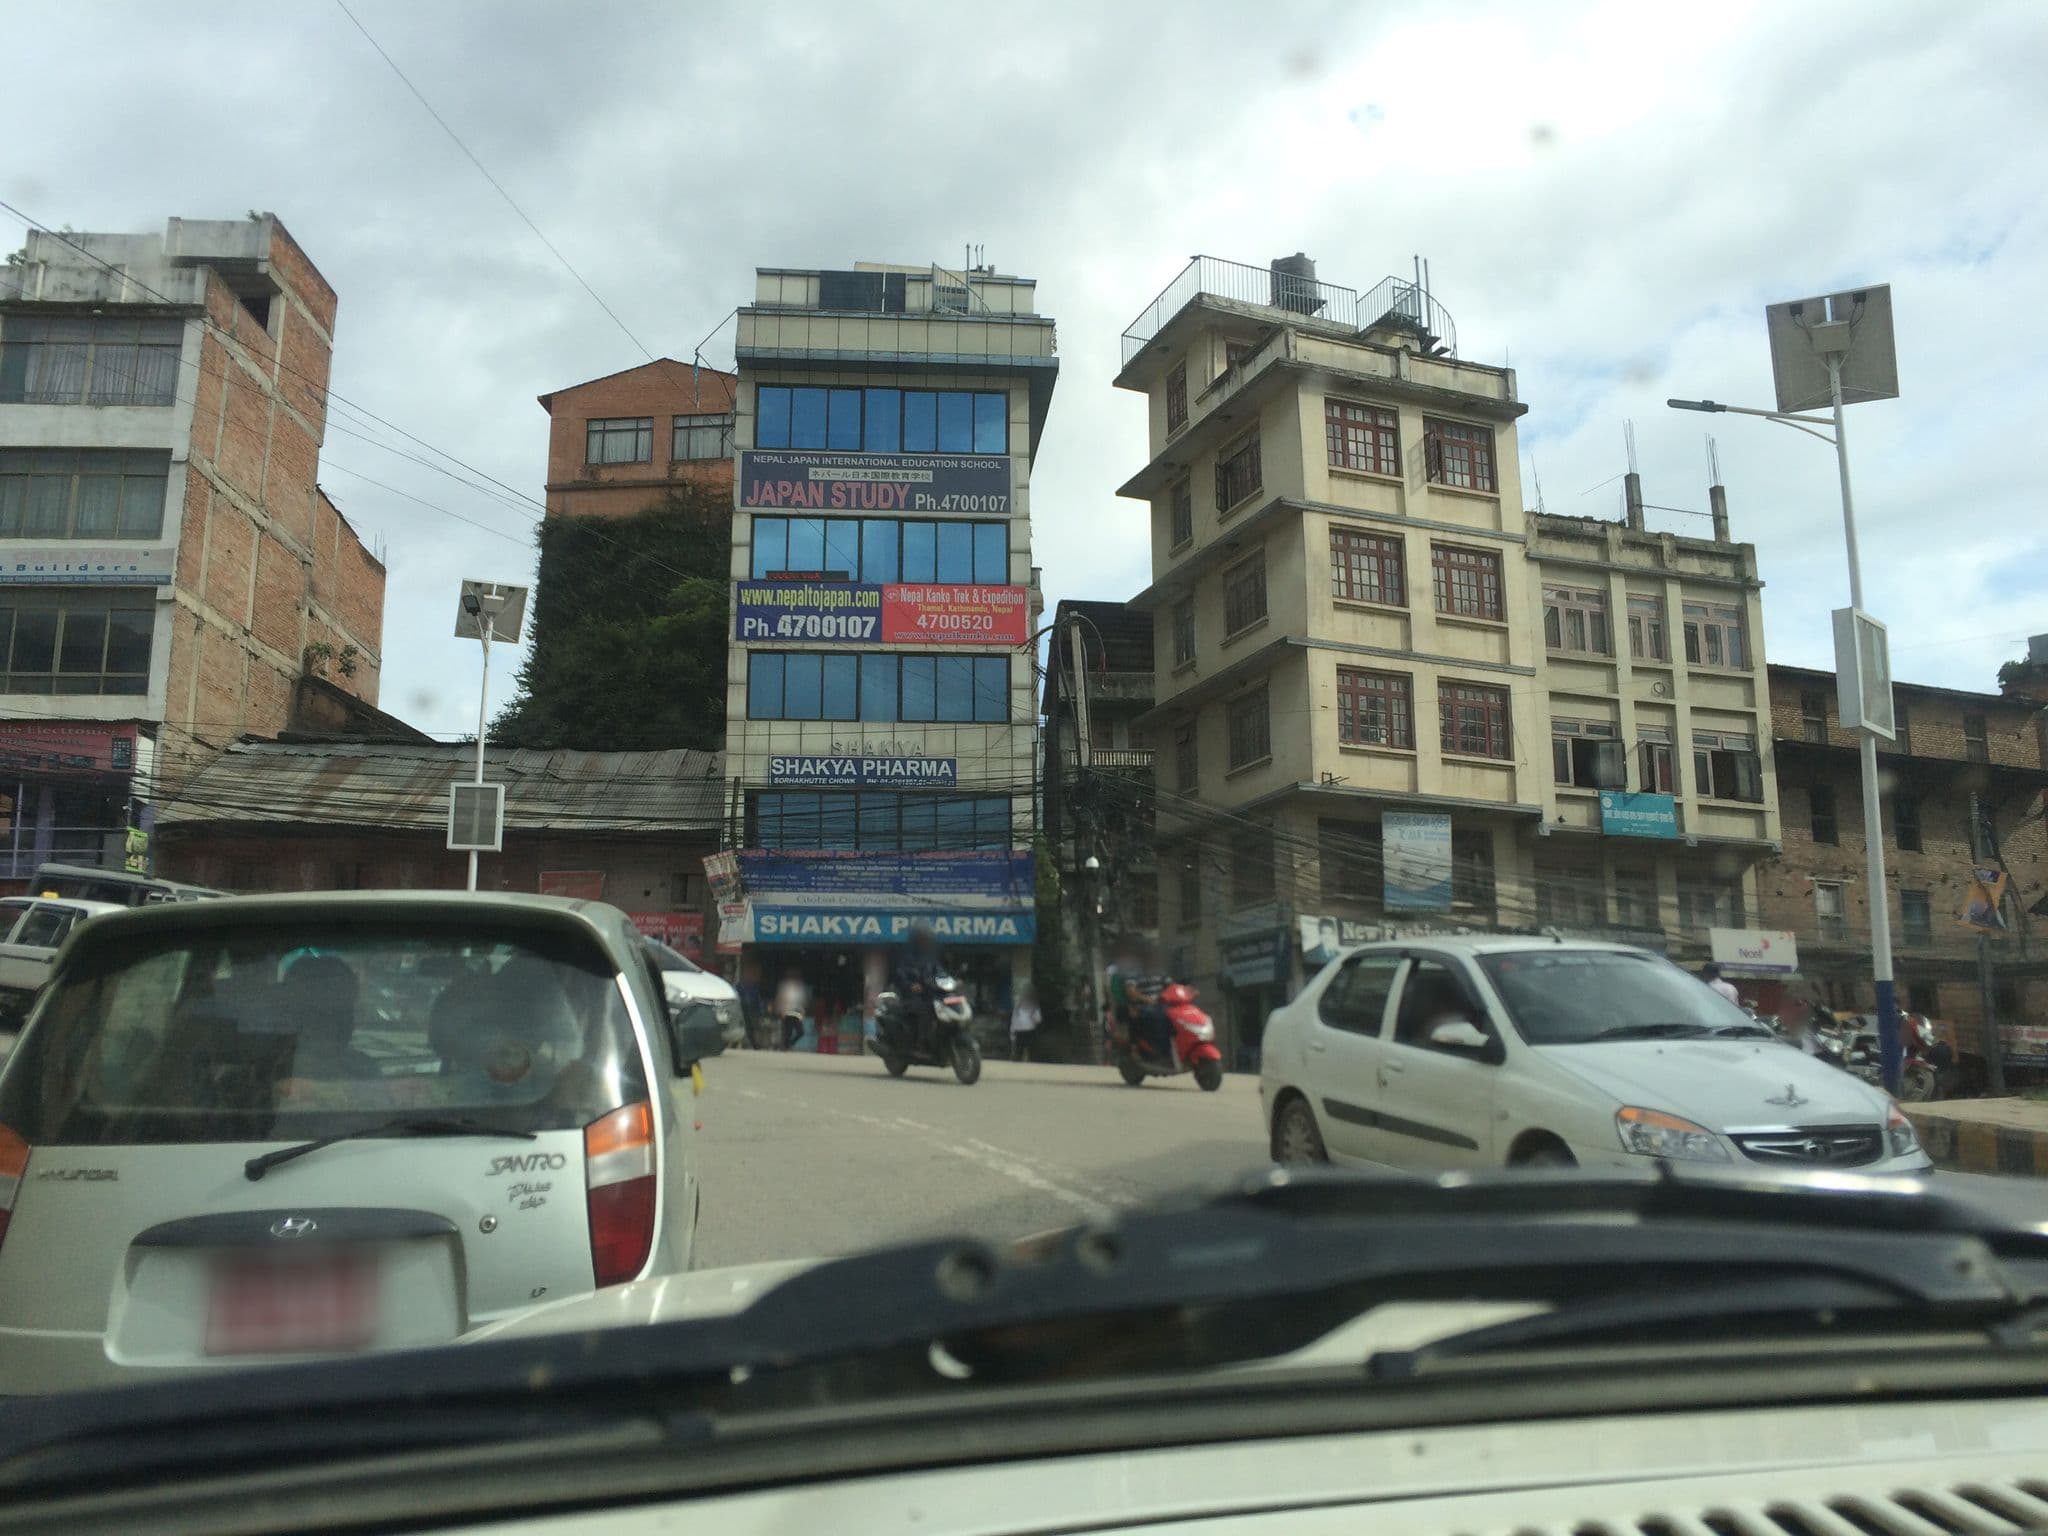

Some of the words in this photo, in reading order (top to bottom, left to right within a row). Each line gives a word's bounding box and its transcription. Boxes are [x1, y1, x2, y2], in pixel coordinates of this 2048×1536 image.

[753, 455, 785, 464] NEPAL
[786, 456, 820, 465] JAPAN
[822, 457, 900, 467] INTERNATIONAL
[902, 459, 958, 468] EDUCATION
[960, 460, 1001, 469] SCHOOL
[746, 480, 824, 507] JAPAN
[831, 481, 911, 509] STUDY
[740, 584, 880, 612] www.nepaltojapan.com
[900, 588, 924, 605] Nepal
[972, 589, 980, 604] &
[982, 589, 1024, 606] Expedition
[917, 614, 993, 630] 4700520
[771, 758, 858, 776] SHAKYA
[862, 759, 953, 777] PHARMA
[759, 914, 882, 935] SHAKYA
[891, 915, 1019, 936] PARMA
[485, 1153, 567, 1177] SANTRO
